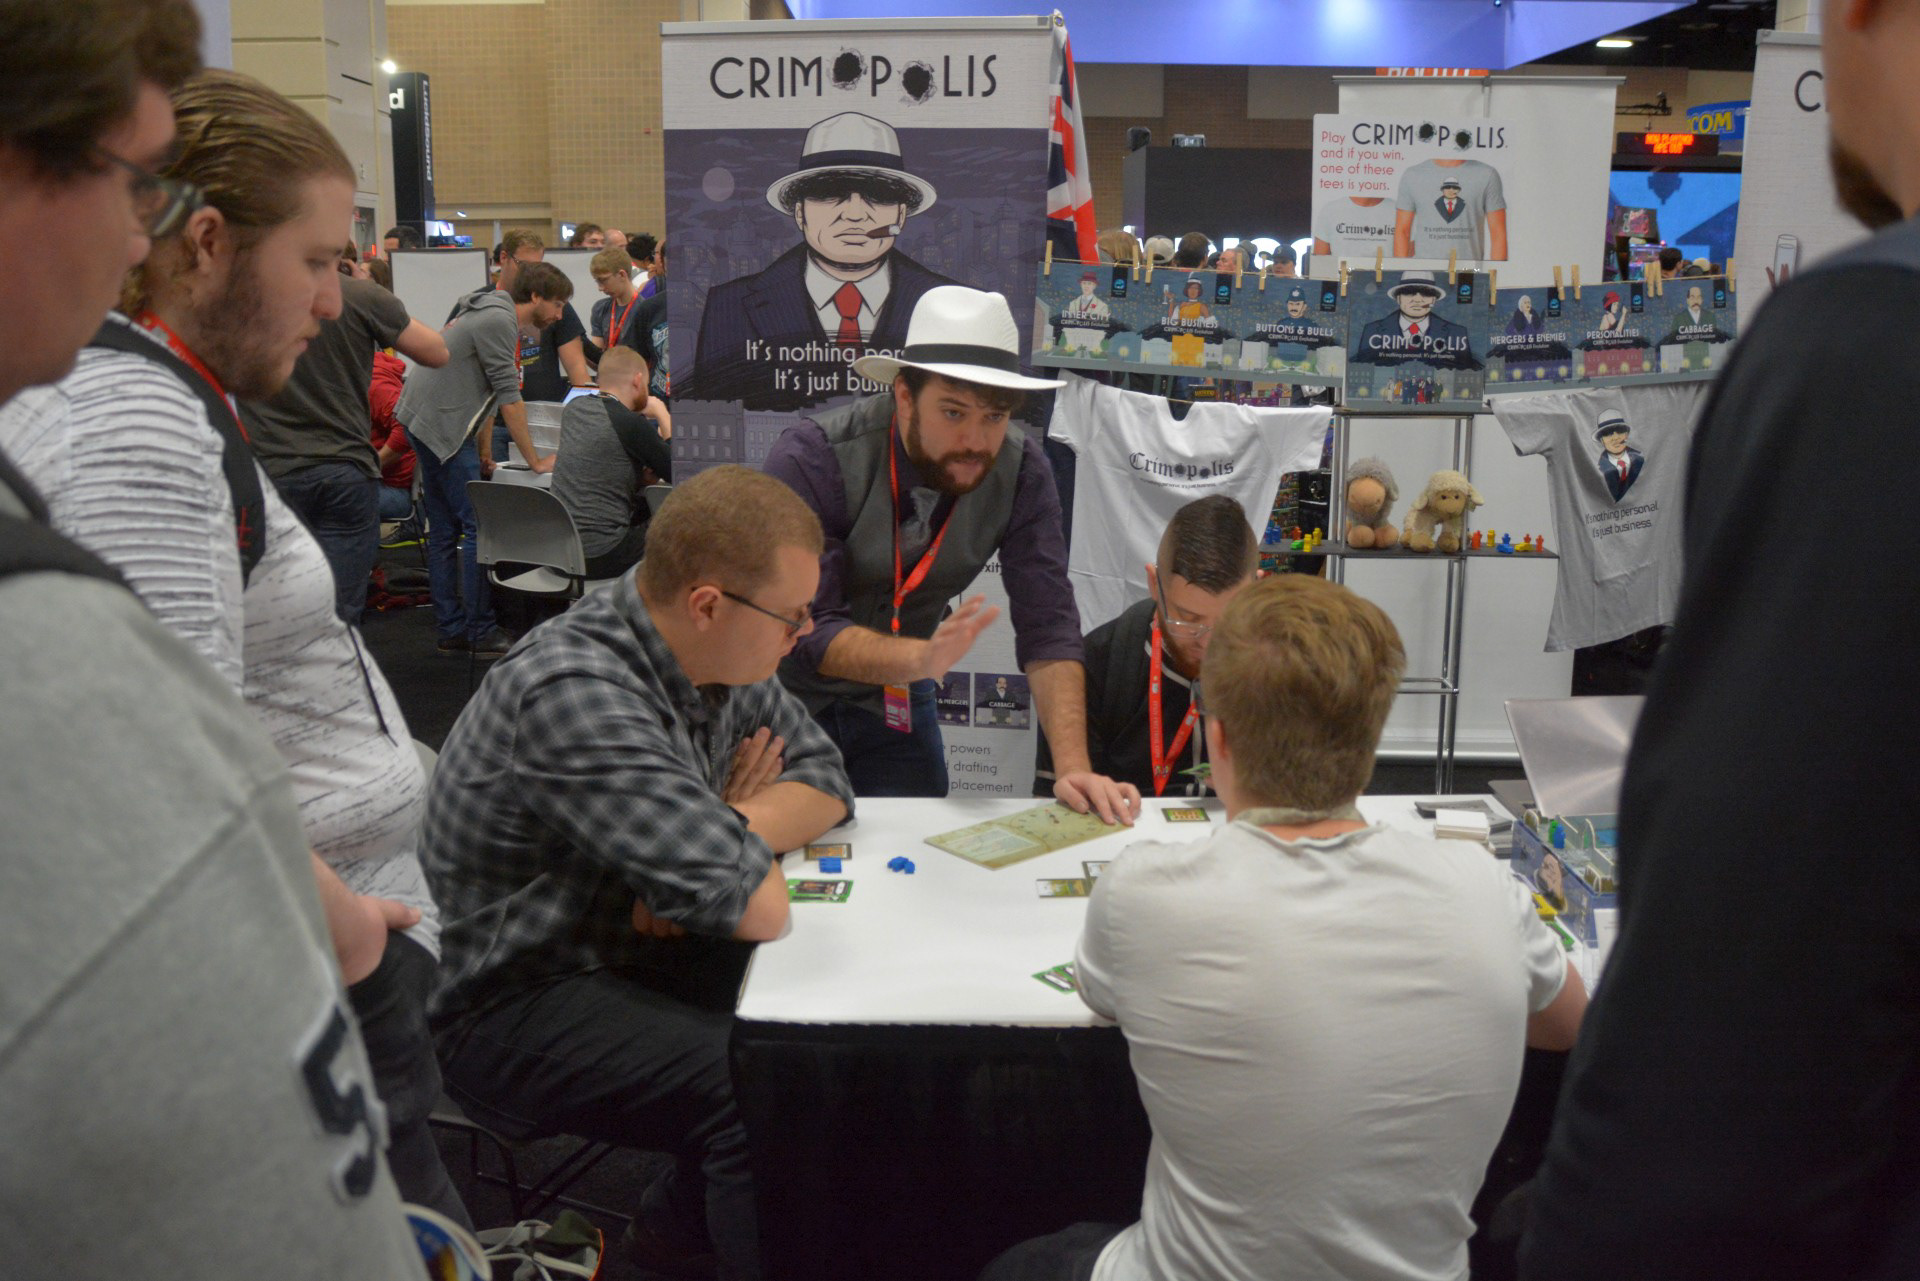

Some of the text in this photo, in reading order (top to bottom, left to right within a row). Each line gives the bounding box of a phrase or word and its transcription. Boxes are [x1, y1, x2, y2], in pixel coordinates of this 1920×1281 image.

[710, 48, 997, 105] CRIMOPOLIS
[1321, 121, 1505, 151] Play CRIMOPOLIS
[1321, 147, 1404, 161] and if you win,
[1320, 162, 1394, 175] one of these
[1320, 178, 1390, 192] tees is yours.
[1061, 309, 1111, 321] INNER CITY
[1161, 316, 1218, 329] BIG BUSINESS
[1255, 323, 1334, 336] BUTTONS & BULLS
[1679, 324, 1713, 334] CABBAGE
[1490, 332, 1566, 345] MERGERS & ENEMIES
[1586, 328, 1639, 339] PERSONALITIES
[1368, 334, 1467, 353] CRIMOPOLIS
[746, 339, 771, 360] It's
[779, 340, 856, 368] nothing
[775, 368, 800, 390] It's
[806, 371, 839, 396] just
[1129, 452, 1234, 480] Crimopolis
[1620, 501, 1659, 518] personal
[1614, 519, 1652, 533] business
[950, 745, 991, 755] powers
[953, 761, 998, 776] drafting
[950, 779, 1013, 792] placement
